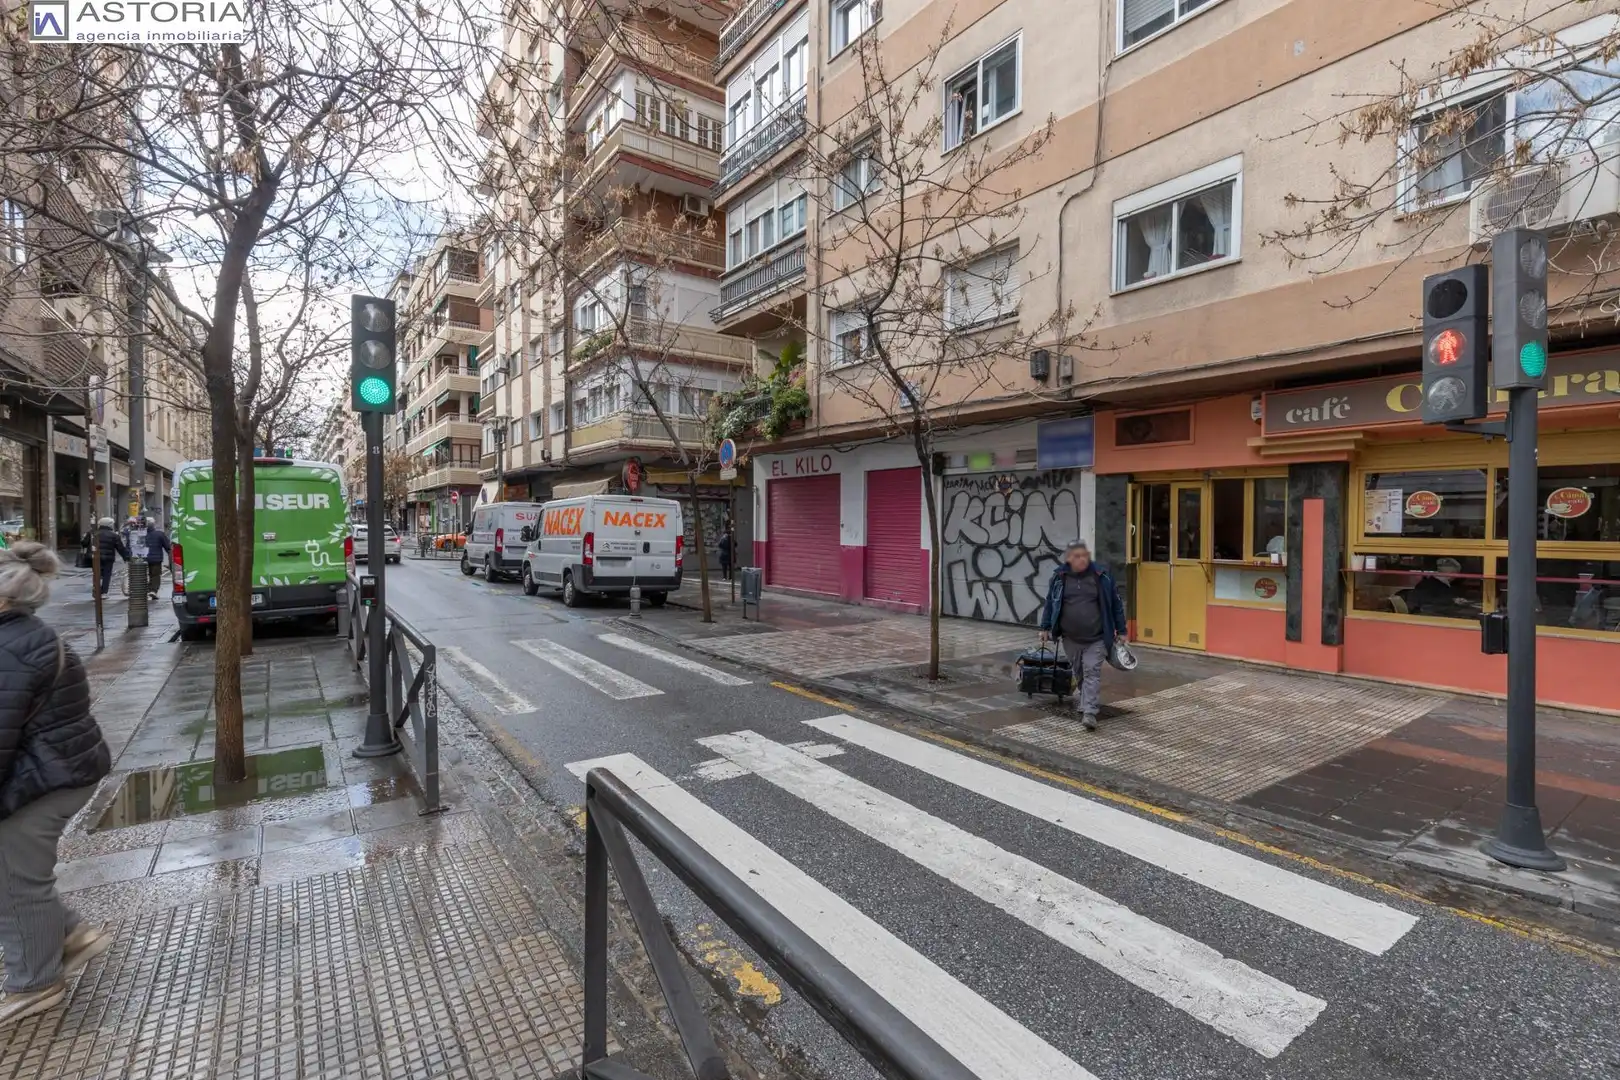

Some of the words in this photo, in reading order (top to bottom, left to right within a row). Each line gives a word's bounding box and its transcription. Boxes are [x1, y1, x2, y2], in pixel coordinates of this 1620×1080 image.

[1285, 396, 1350, 424] café
[1386, 369, 1620, 413] Cra
[772, 460, 788, 476] EL
[795, 454, 832, 474] KILO
[266, 493, 330, 510] SEUR
[544, 508, 585, 536] NACEX
[603, 511, 667, 528] NACEX
